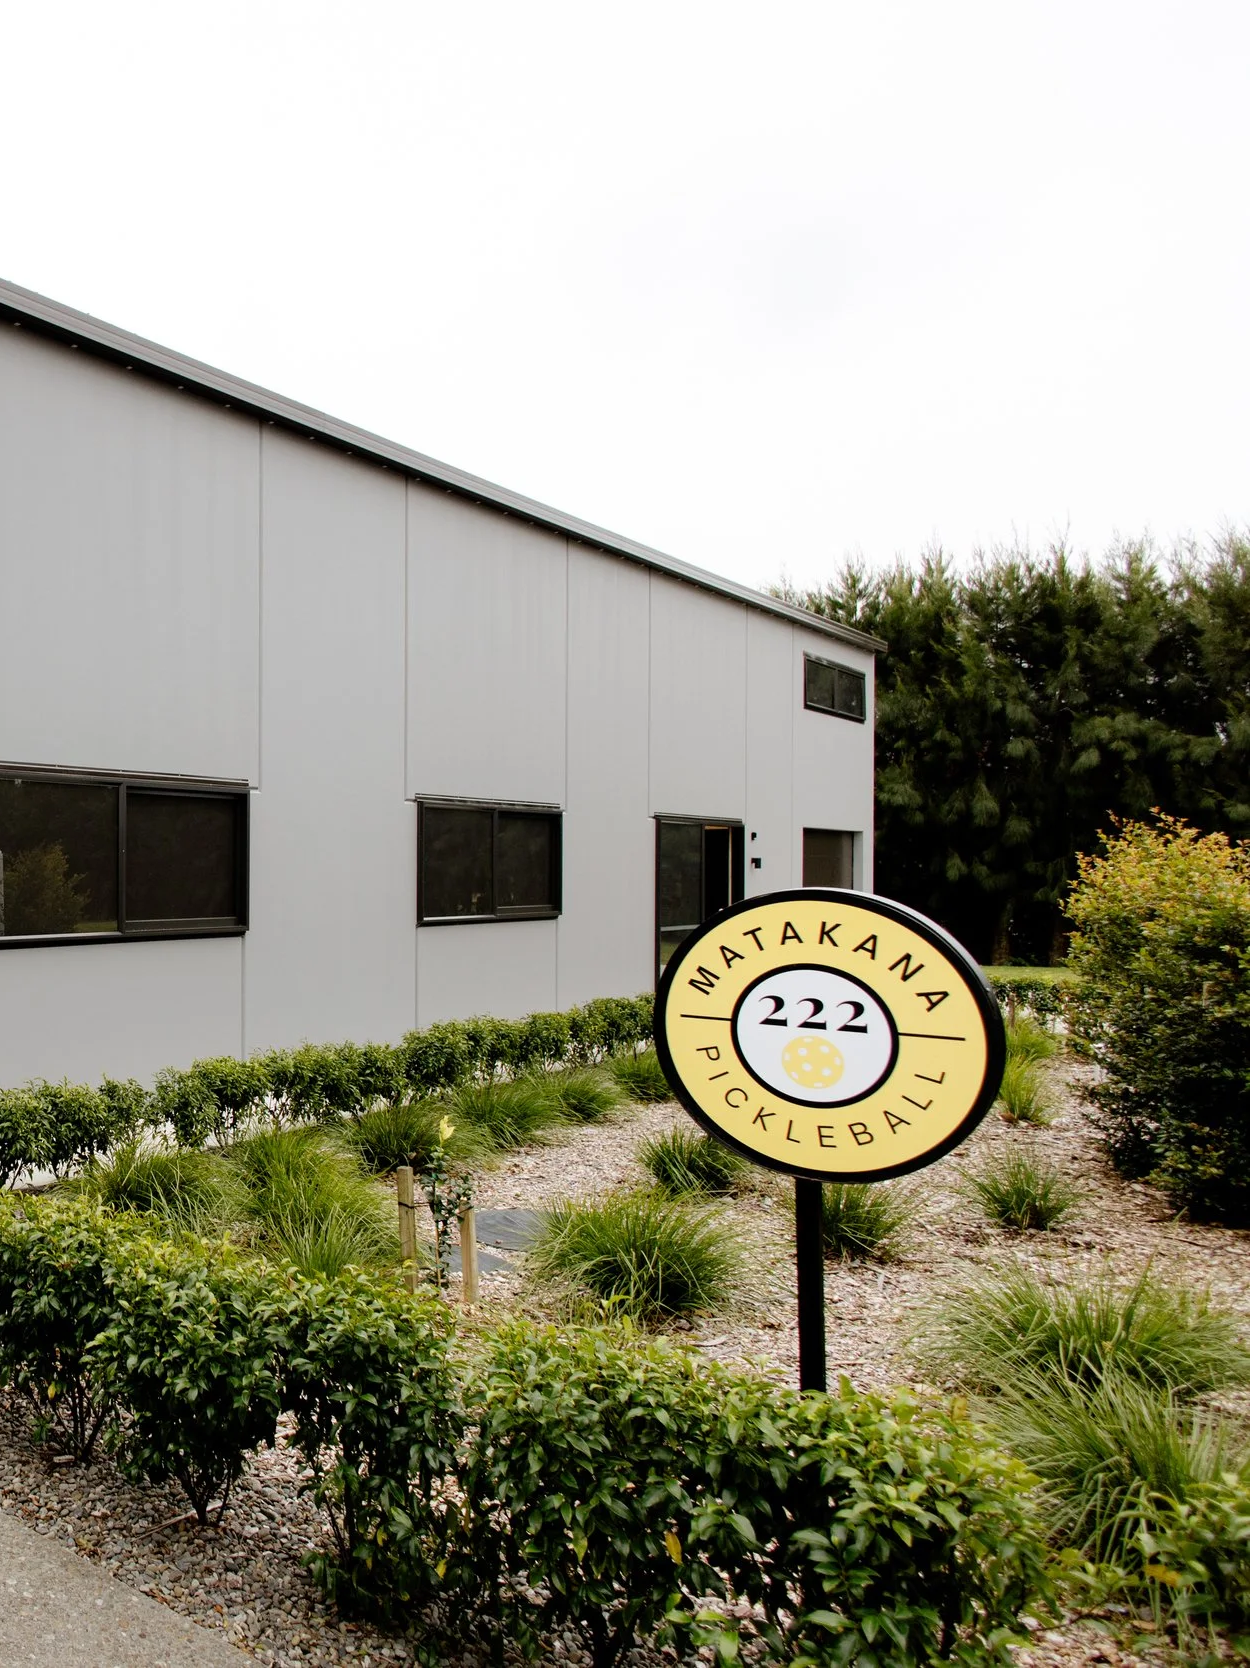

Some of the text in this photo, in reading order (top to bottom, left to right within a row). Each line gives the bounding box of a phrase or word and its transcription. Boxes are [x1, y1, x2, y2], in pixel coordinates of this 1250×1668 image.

[688, 921, 950, 1013] MATAKANA
[758, 995, 868, 1034] 222
[696, 1045, 946, 1148] PICKLEBALL
